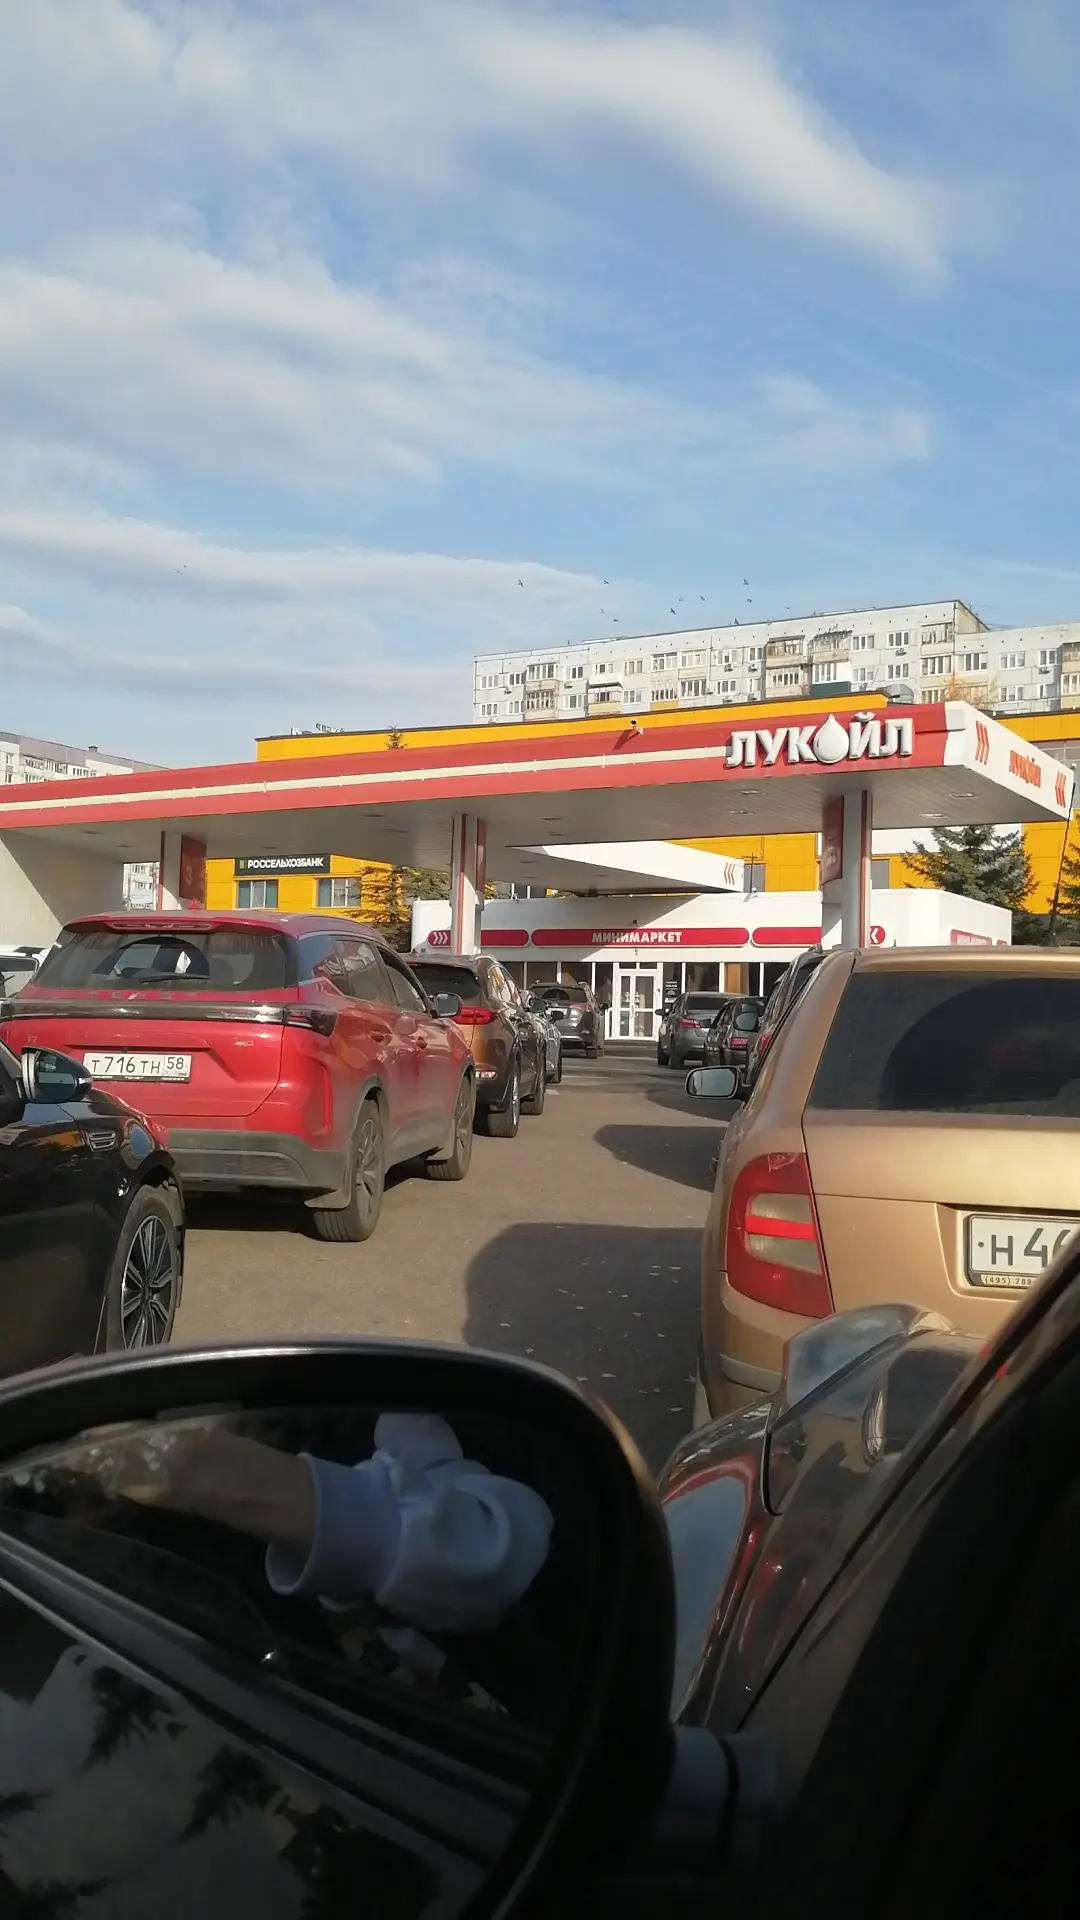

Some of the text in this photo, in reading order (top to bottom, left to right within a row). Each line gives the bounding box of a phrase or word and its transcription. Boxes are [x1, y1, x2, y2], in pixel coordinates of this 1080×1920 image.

[725, 712, 913, 767] ЛУКОЙЛ
[247, 857, 324, 869] РОССЕЛЬХОЗБАНК
[591, 931, 682, 943] МИНИМАРКЕТ
[167, 1057, 184, 1070] 58
[984, 1275, 1011, 1286] (495)
